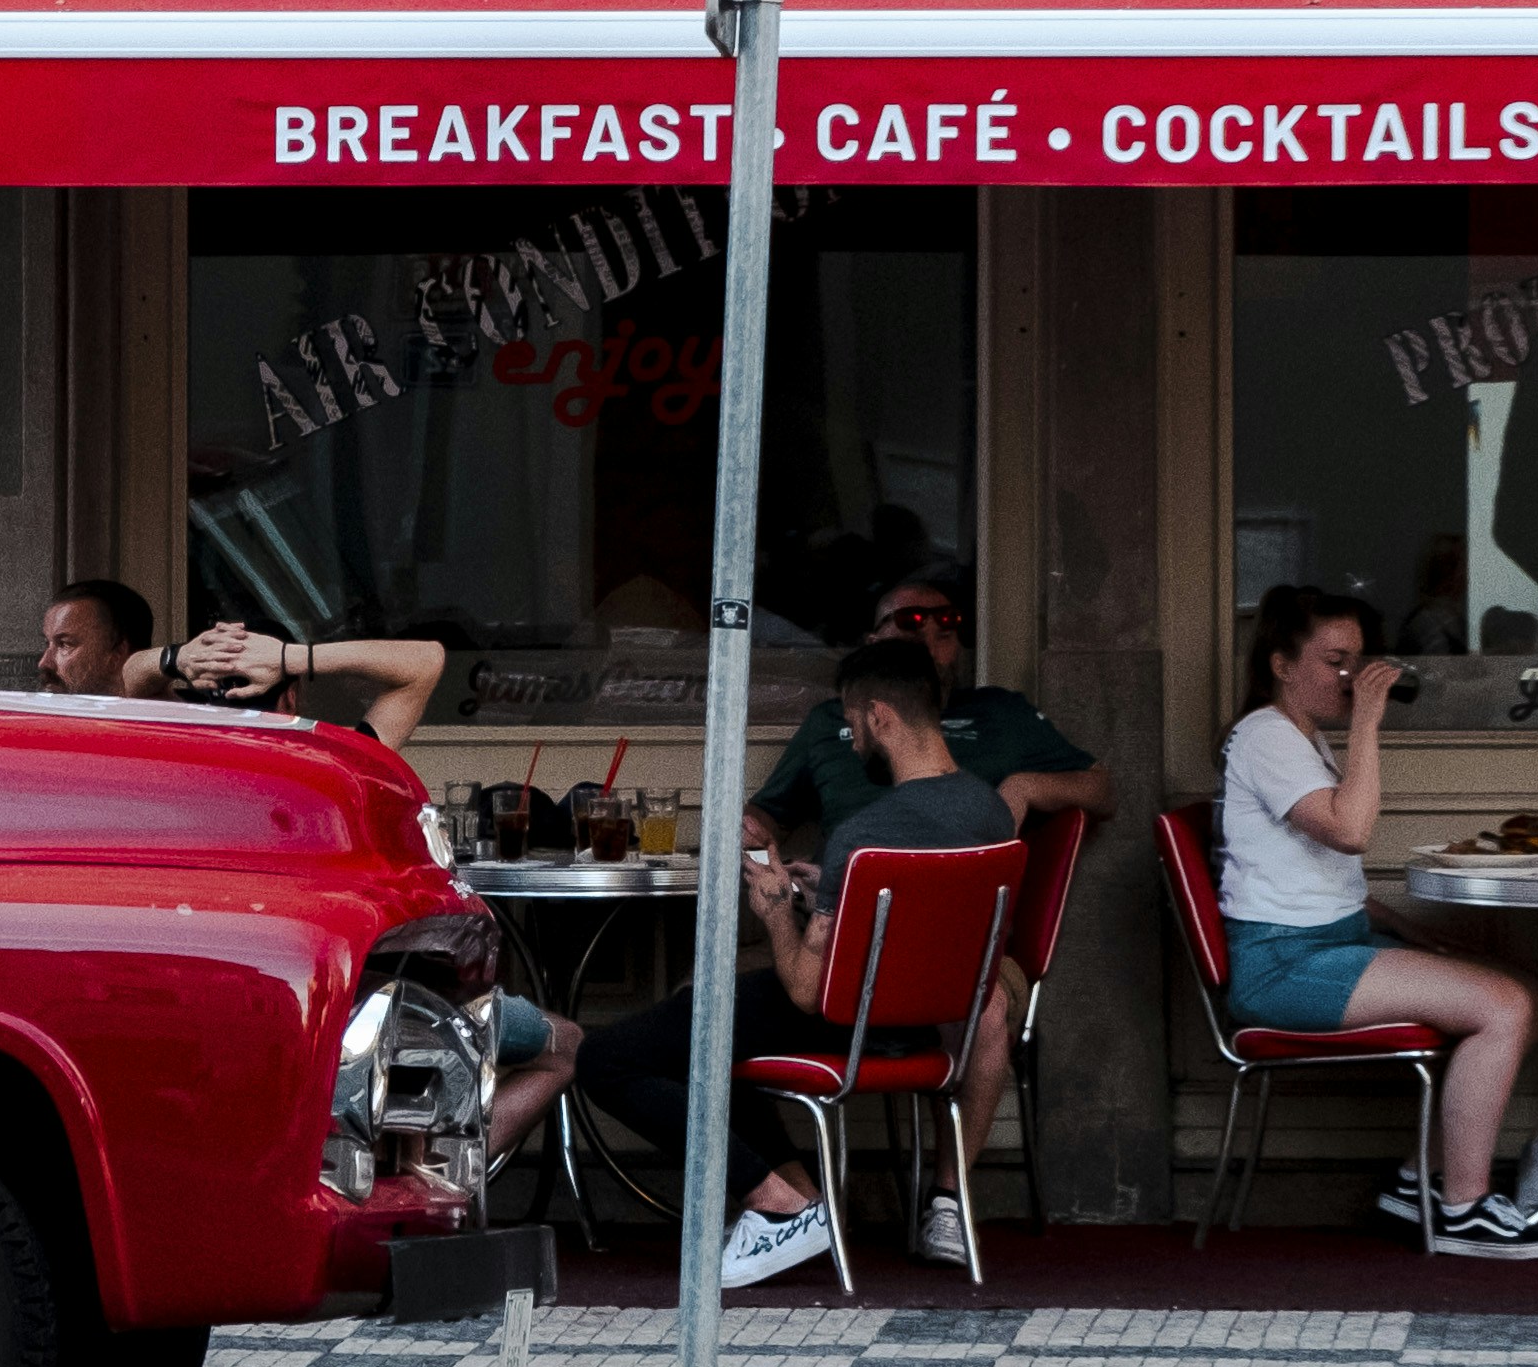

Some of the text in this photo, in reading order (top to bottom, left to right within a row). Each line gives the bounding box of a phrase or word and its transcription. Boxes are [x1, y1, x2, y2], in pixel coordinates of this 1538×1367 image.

[275, 104, 733, 163] BREAKFAST
[816, 88, 1018, 162] CAFÉ
[256, 313, 407, 451] AIR
